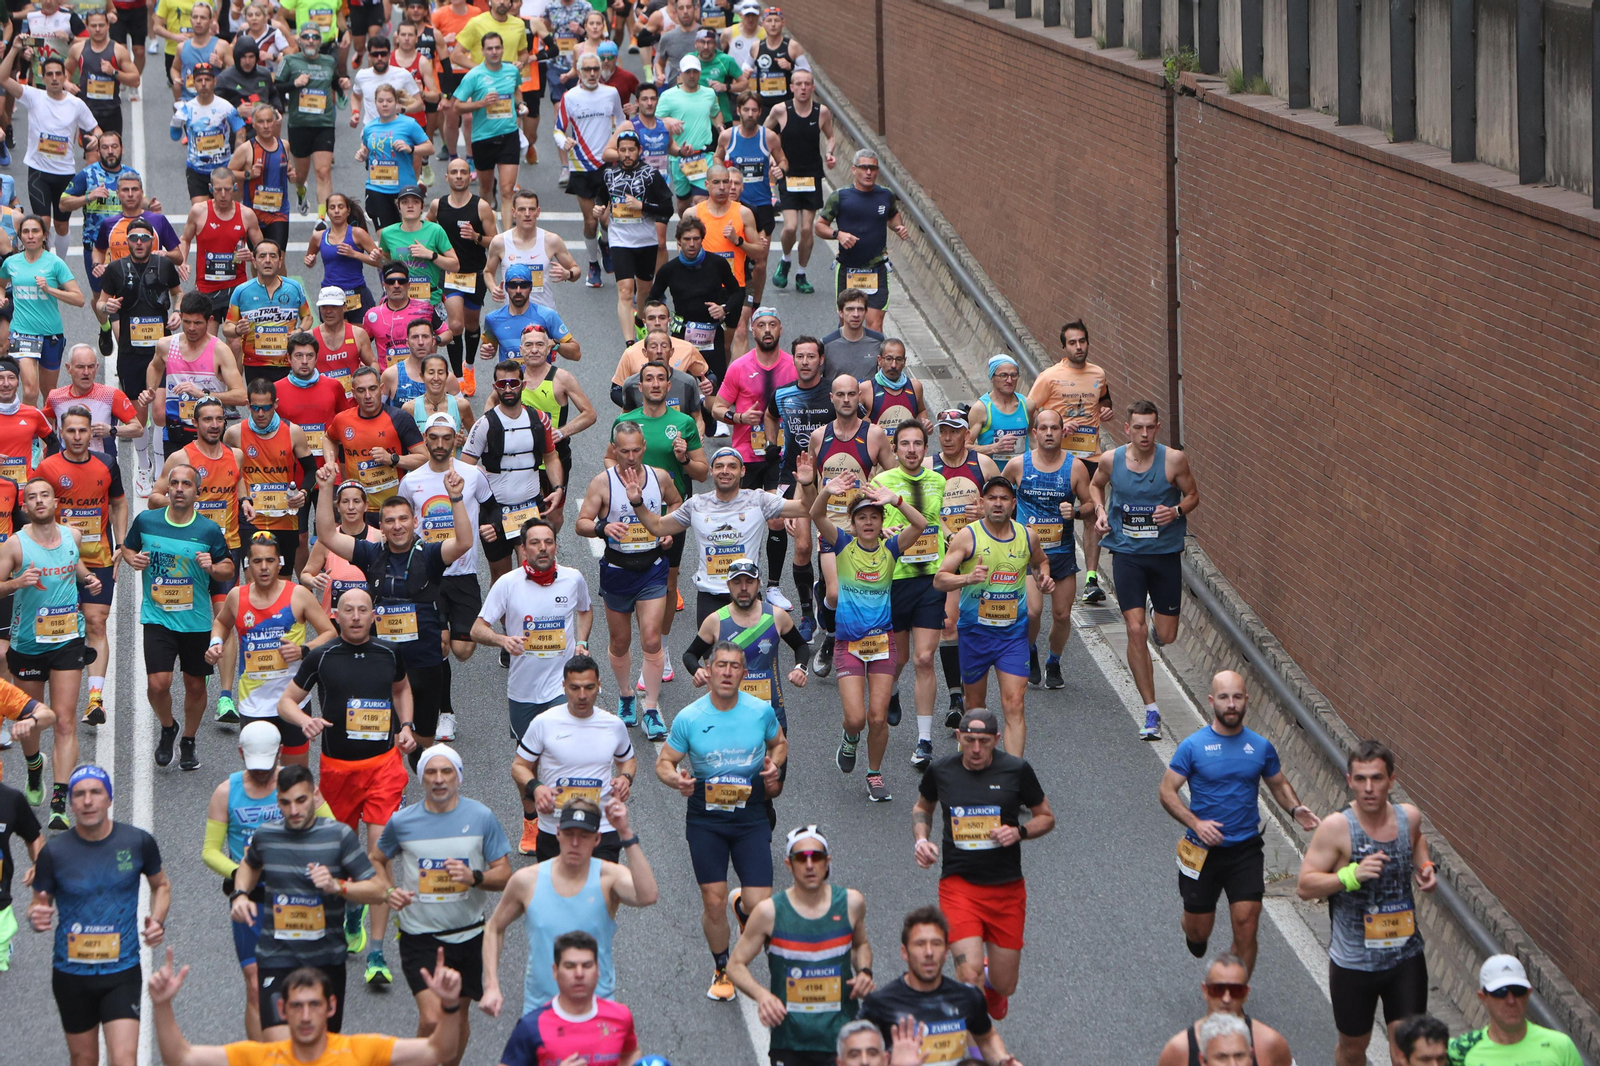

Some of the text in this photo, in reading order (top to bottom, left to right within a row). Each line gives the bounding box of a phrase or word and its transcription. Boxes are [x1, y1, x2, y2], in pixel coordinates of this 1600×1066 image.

[259, 308, 279, 316] TRAIL
[254, 314, 275, 322] TEAM
[326, 351, 348, 361] DATO
[330, 370, 348, 378] ZURICH
[790, 416, 802, 424] Los
[246, 630, 286, 642] PALACIEGO
[722, 776, 747, 784] ZURICH
[1382, 902, 1408, 911] ZURICH
[84, 924, 114, 933] ZURICH
[806, 968, 835, 976] ZURICH
[932, 1021, 960, 1030] ZURICH
